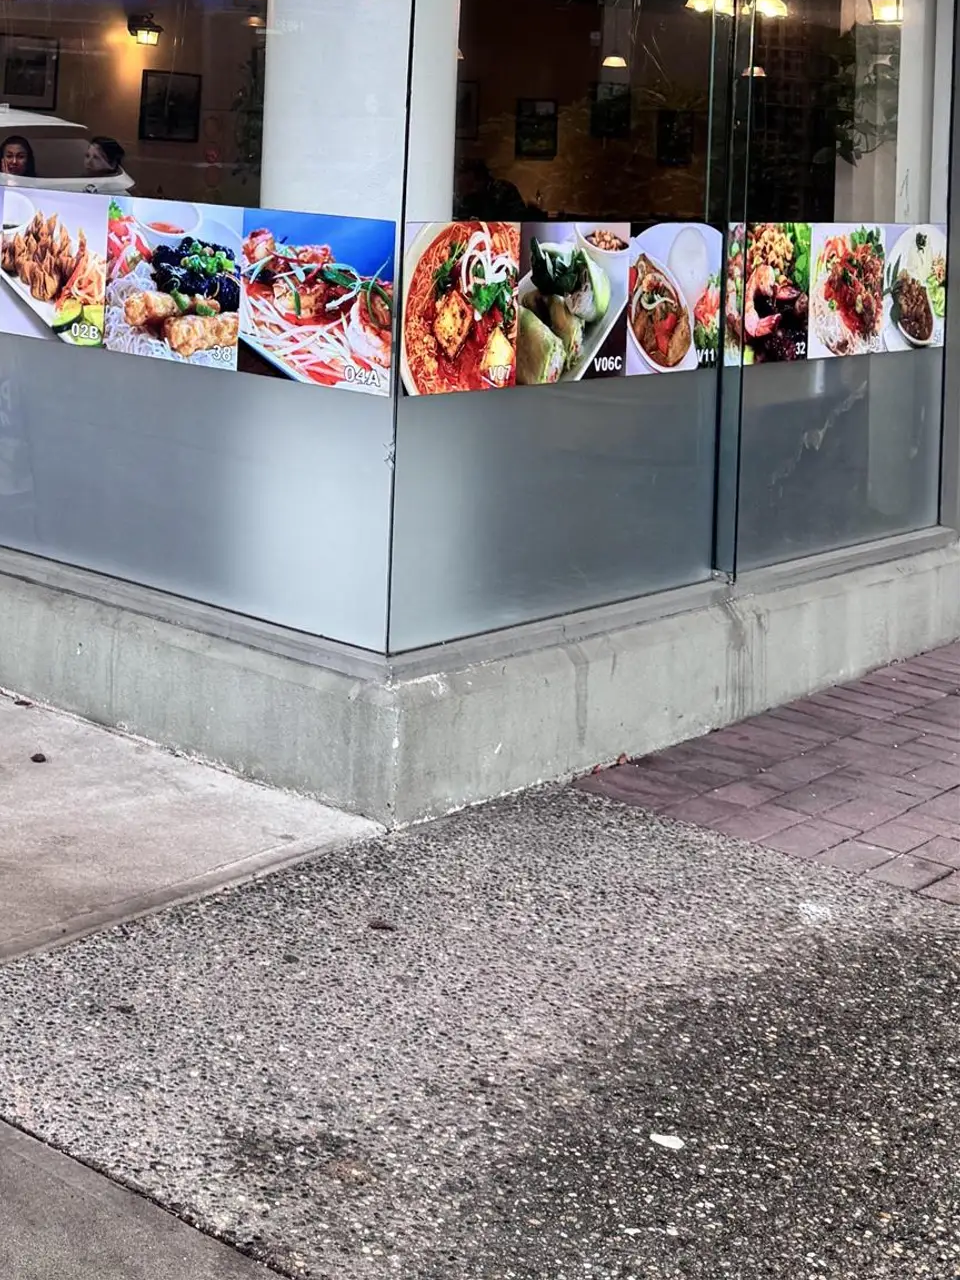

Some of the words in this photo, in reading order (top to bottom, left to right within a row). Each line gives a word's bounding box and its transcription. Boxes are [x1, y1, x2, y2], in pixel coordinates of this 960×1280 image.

[70, 322, 99, 341] 02B
[212, 345, 233, 362] 38
[696, 348, 715, 362] V11
[795, 342, 806, 355] 32
[489, 364, 511, 381] V07
[594, 356, 622, 372] V06C
[344, 364, 381, 387] 04A
